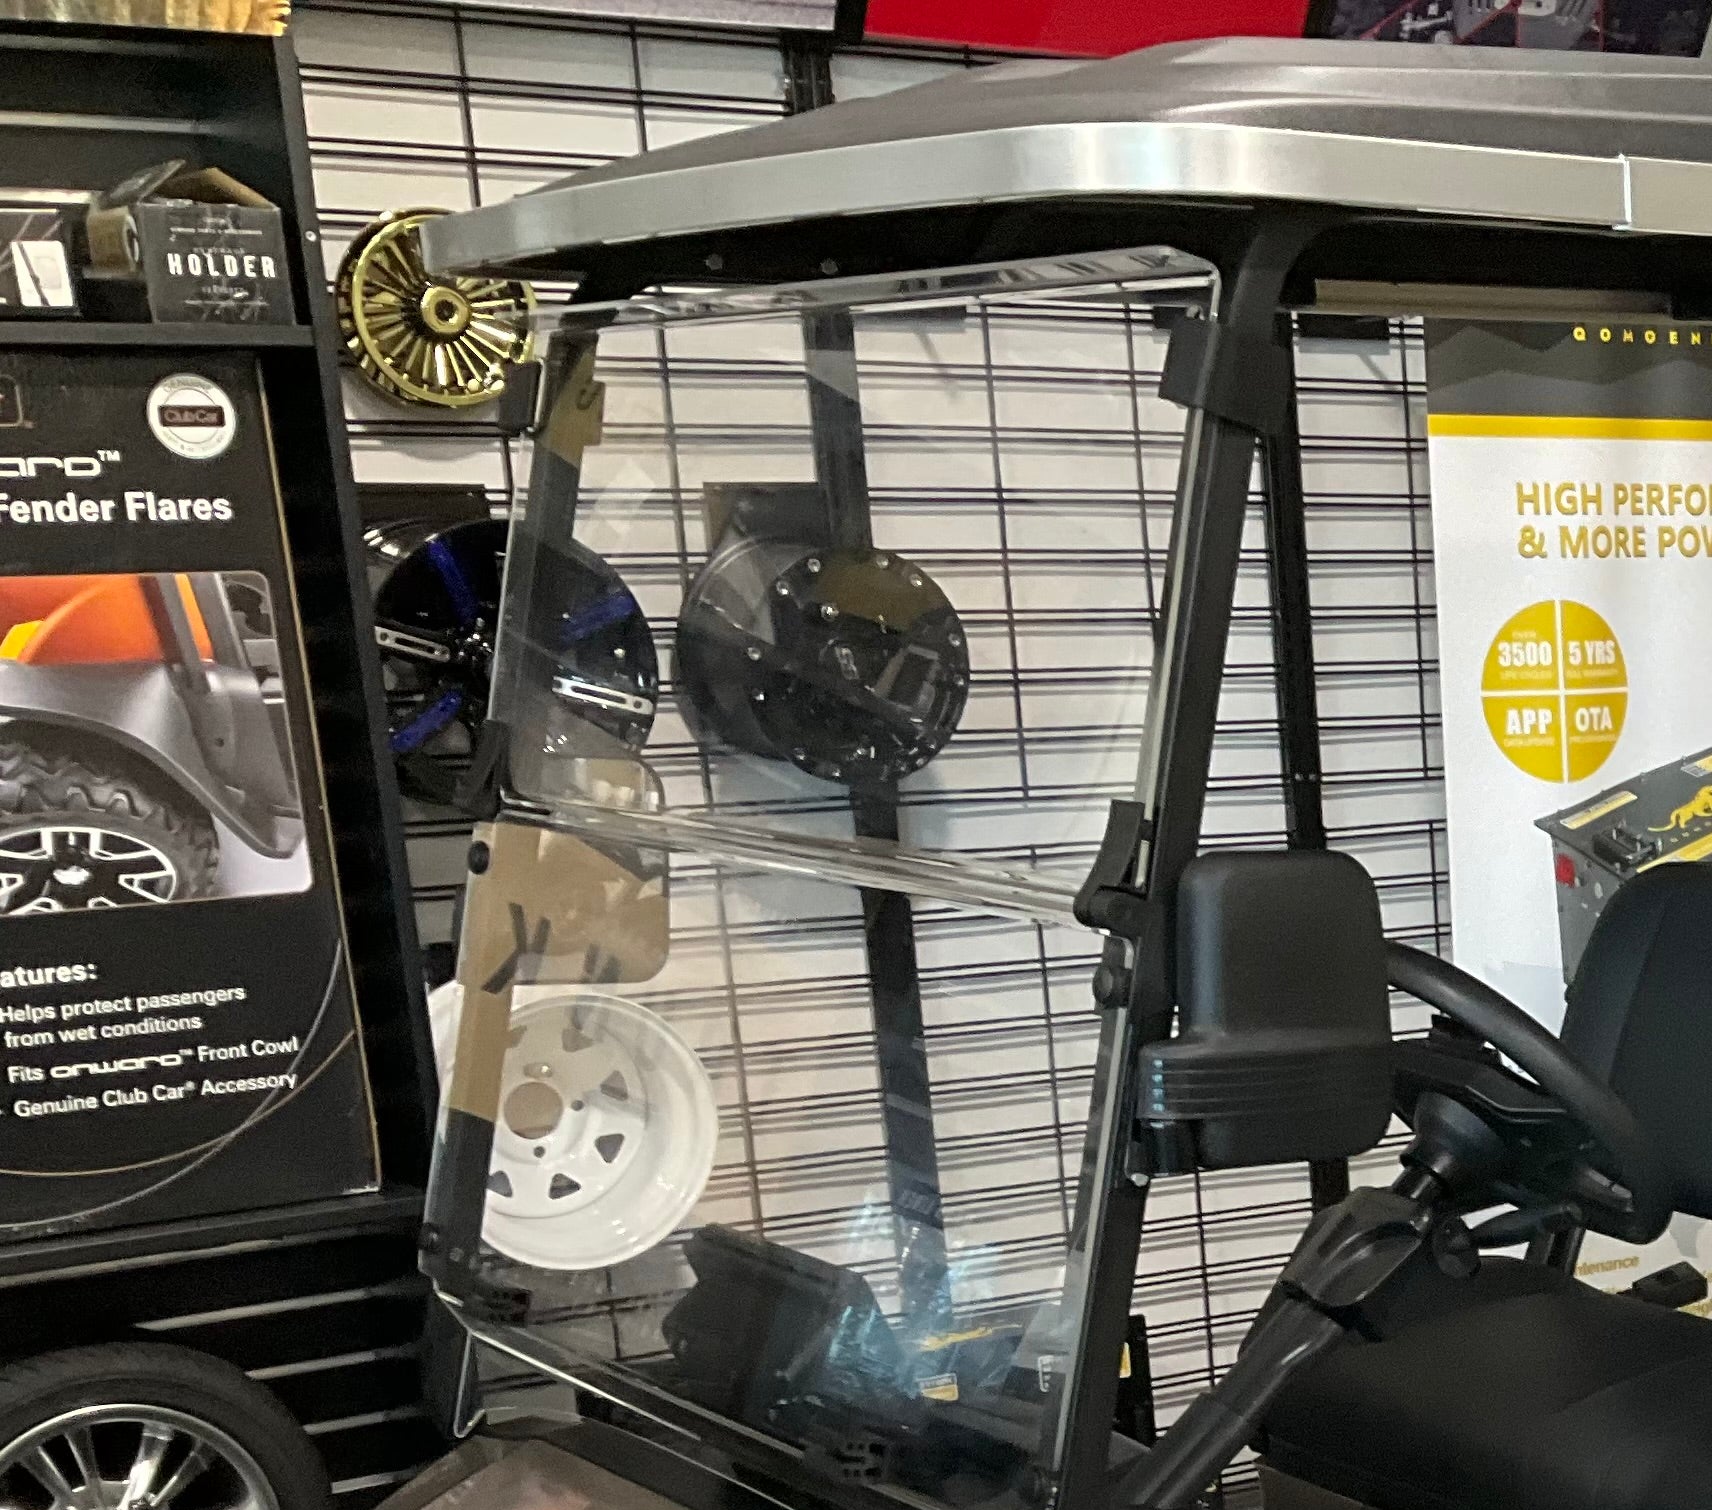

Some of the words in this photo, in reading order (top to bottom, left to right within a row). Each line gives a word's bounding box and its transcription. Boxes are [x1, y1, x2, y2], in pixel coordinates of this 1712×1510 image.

[167, 252, 276, 278] HOLDER
[124, 489, 234, 522] Flares
[1515, 481, 1603, 516] HIGH
[1516, 524, 1548, 559] &
[1559, 525, 1648, 559] MORE
[1498, 641, 1553, 667] 3500
[1568, 641, 1582, 666] 5
[1584, 640, 1616, 665] YRS
[1506, 708, 1553, 735] APP
[1575, 706, 1613, 732] OTA
[0, 1003, 57, 1024] Helps
[60, 996, 133, 1021] protect
[136, 987, 247, 1013] passengers
[4, 1030, 55, 1049] from
[57, 1025, 98, 1043] wet
[100, 1016, 203, 1039] conditions
[7, 1065, 46, 1083] Fits
[197, 1043, 249, 1062] Front
[251, 1035, 300, 1056] Cowl
[13, 1094, 99, 1118] Genuine
[102, 1087, 149, 1107] Club
[201, 1073, 299, 1096] Accessory
